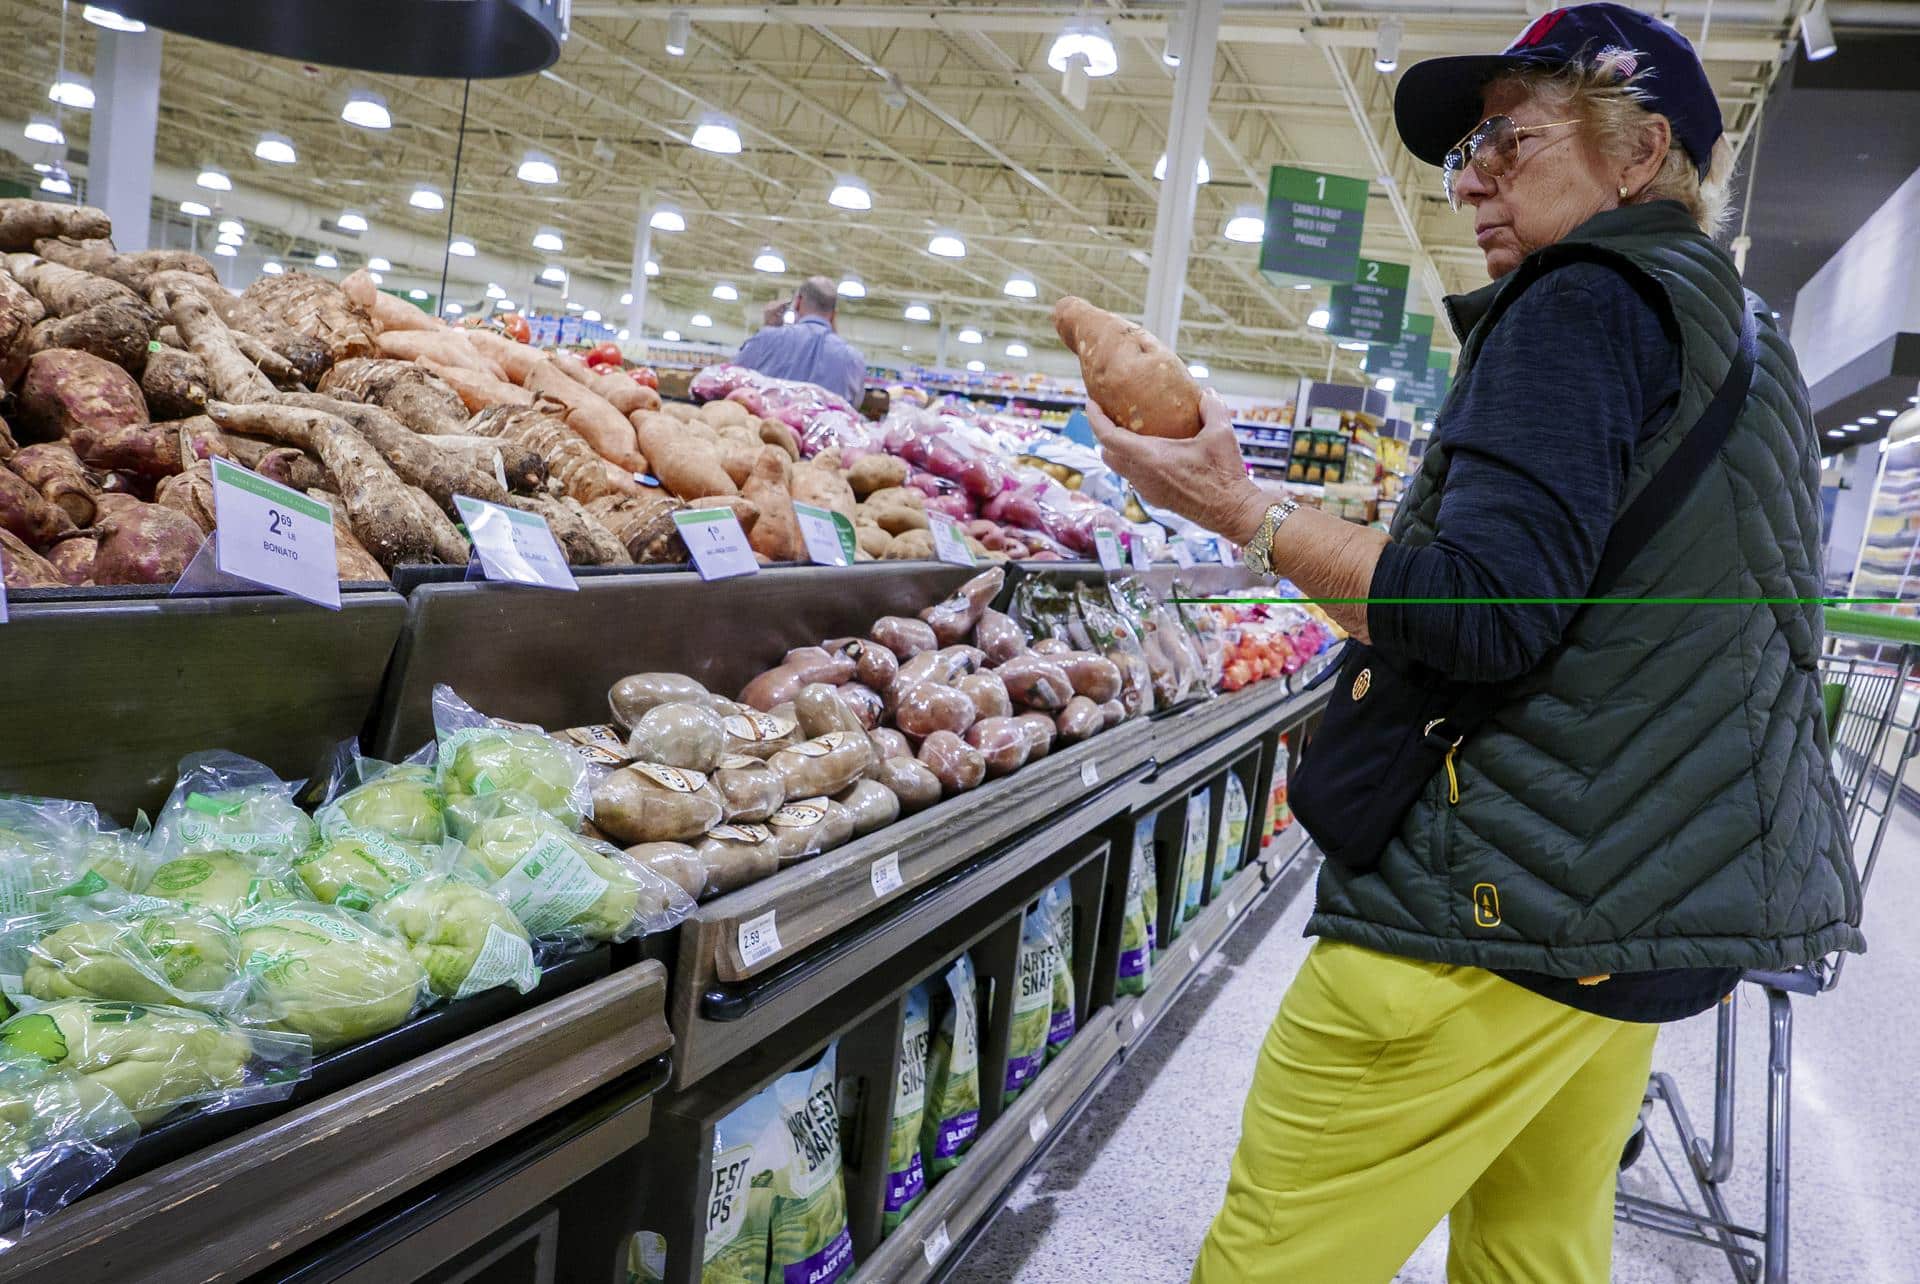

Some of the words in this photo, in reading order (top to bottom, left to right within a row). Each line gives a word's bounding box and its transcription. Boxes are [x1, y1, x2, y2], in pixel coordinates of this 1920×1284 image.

[1315, 176, 1327, 201] 1
[1366, 262, 1380, 282] 2
[263, 540, 299, 561] BONIATO
[711, 1157, 751, 1198] EST
[705, 1194, 732, 1232] PS
